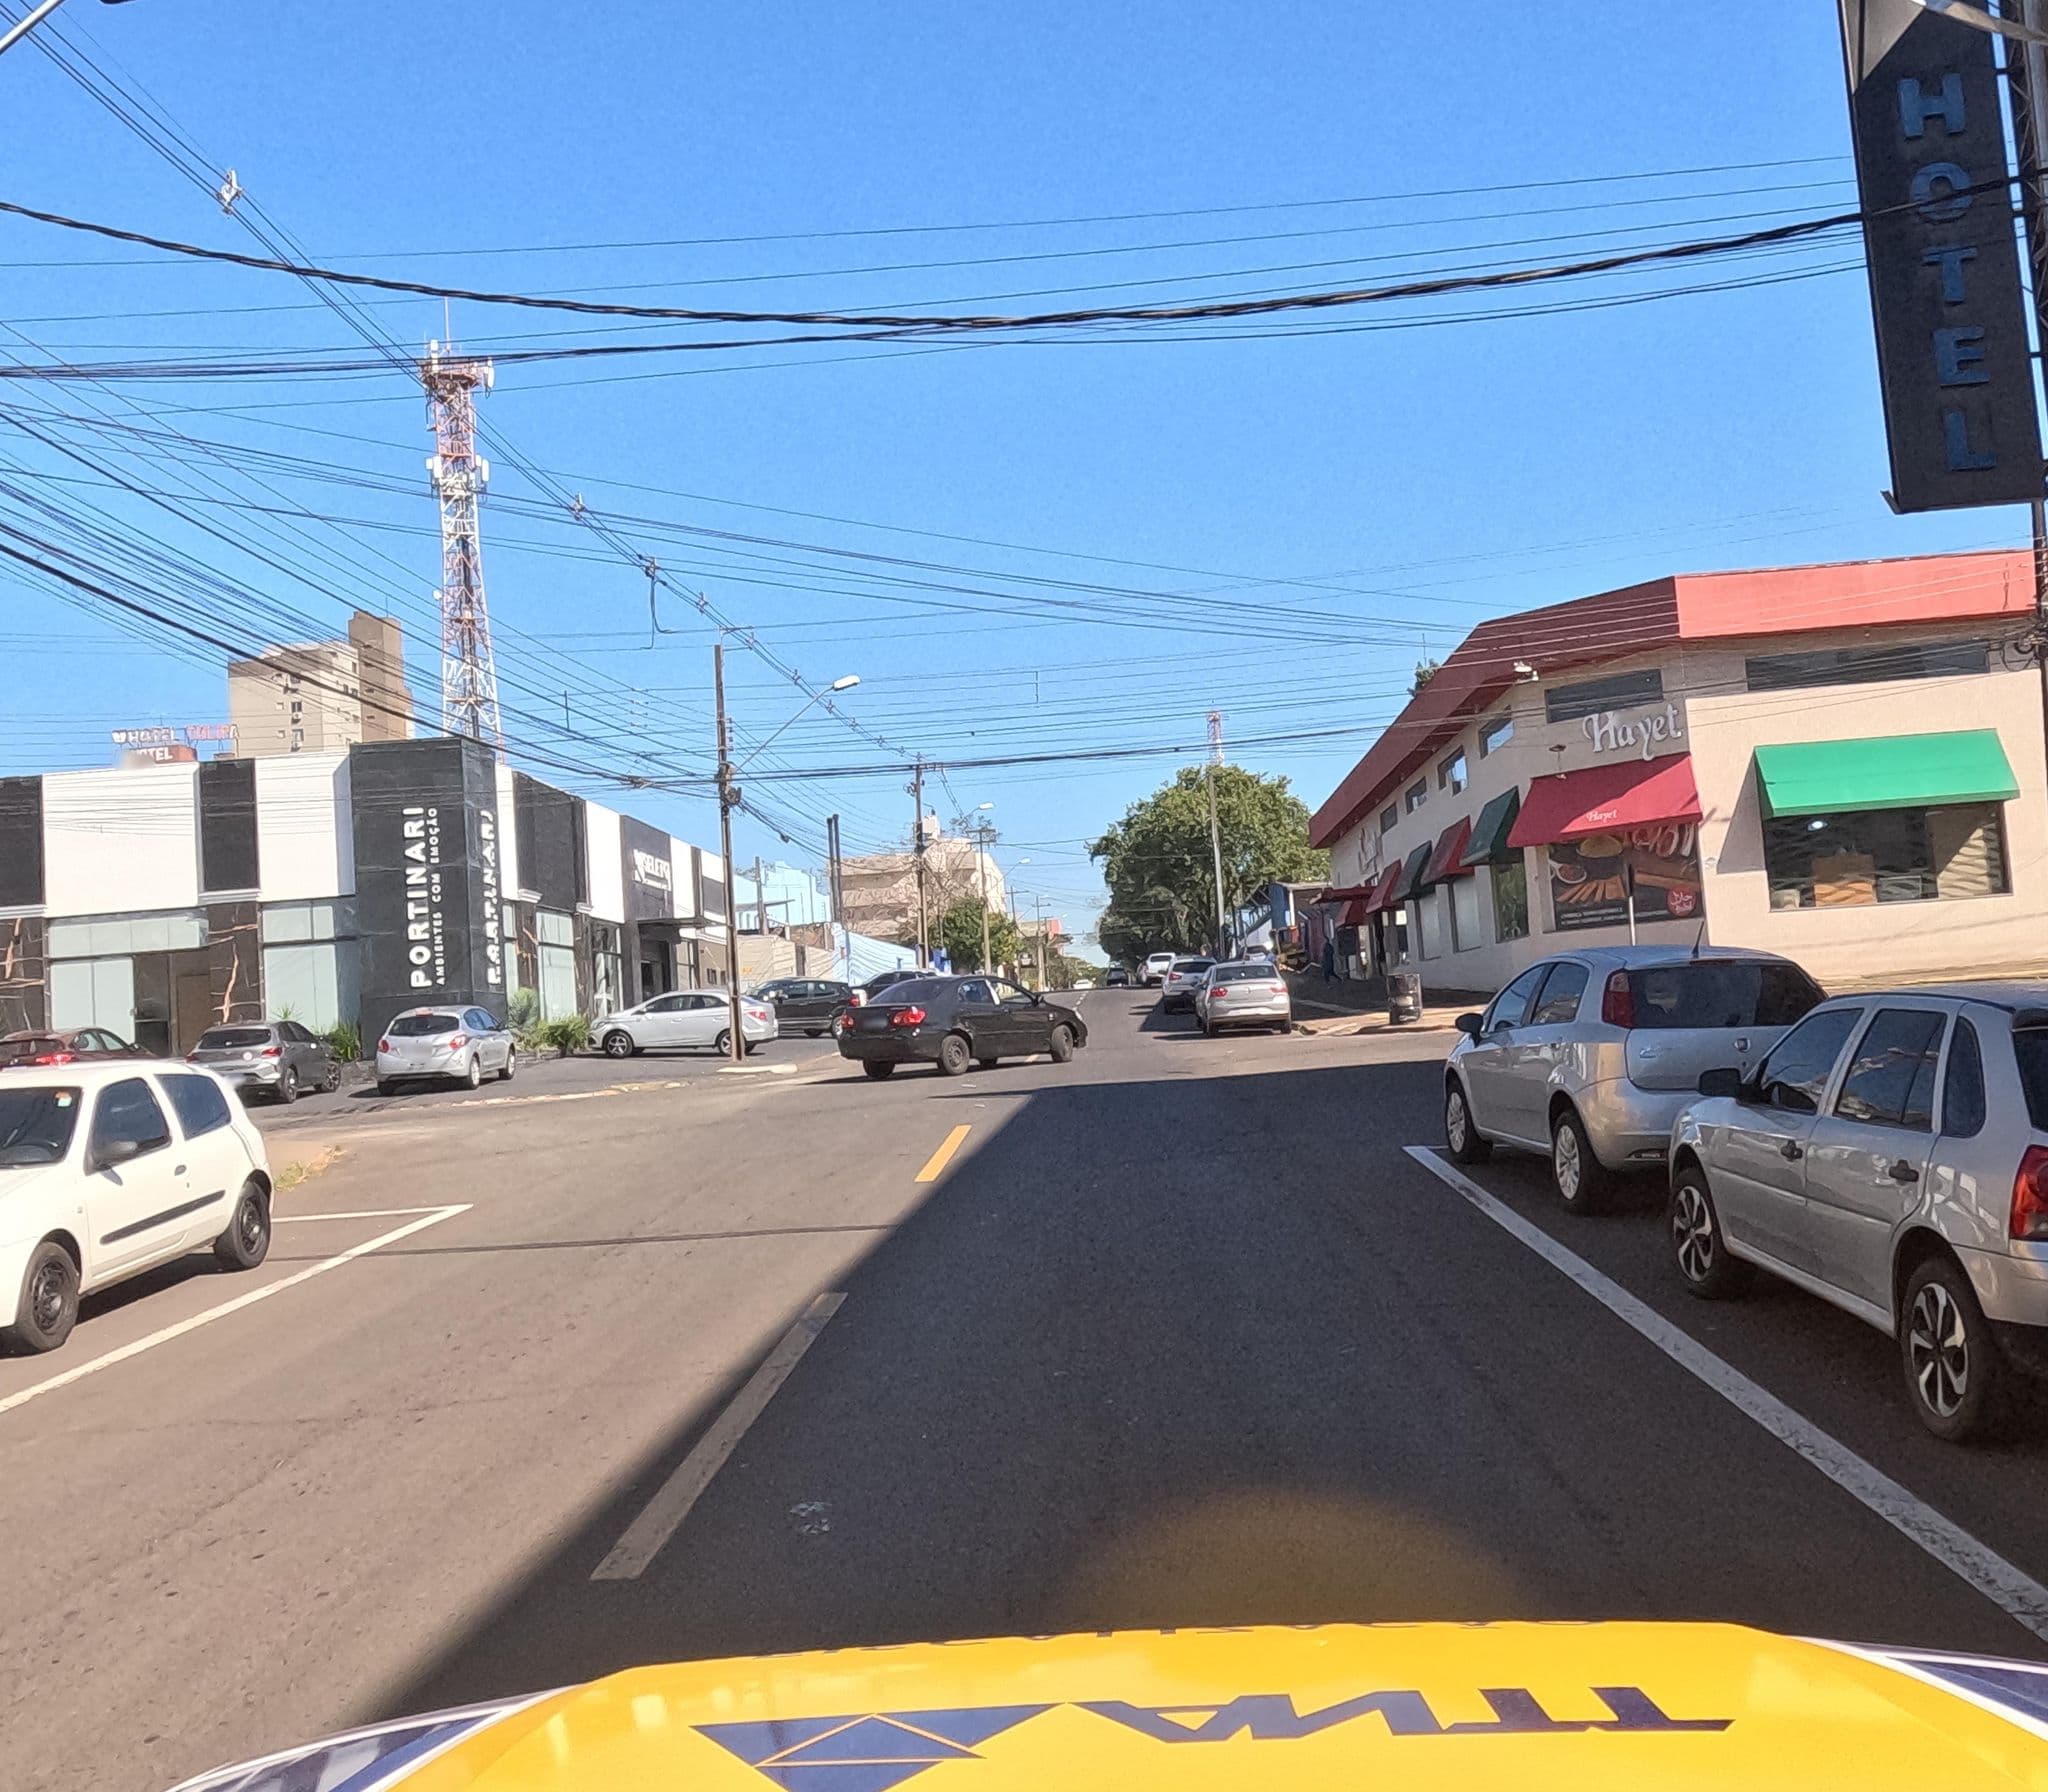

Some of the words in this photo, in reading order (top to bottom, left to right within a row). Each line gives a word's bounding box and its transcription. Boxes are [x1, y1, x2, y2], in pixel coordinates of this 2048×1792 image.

[1896, 72, 1997, 472] HOTEL
[1582, 703, 1682, 761] Hayet
[426, 807, 440, 864] EMOÇÃO
[1585, 808, 1618, 824] Hayet
[402, 807, 433, 988] PORTINARI
[430, 873, 442, 902] COM
[431, 911, 446, 986] AMBIENTES
